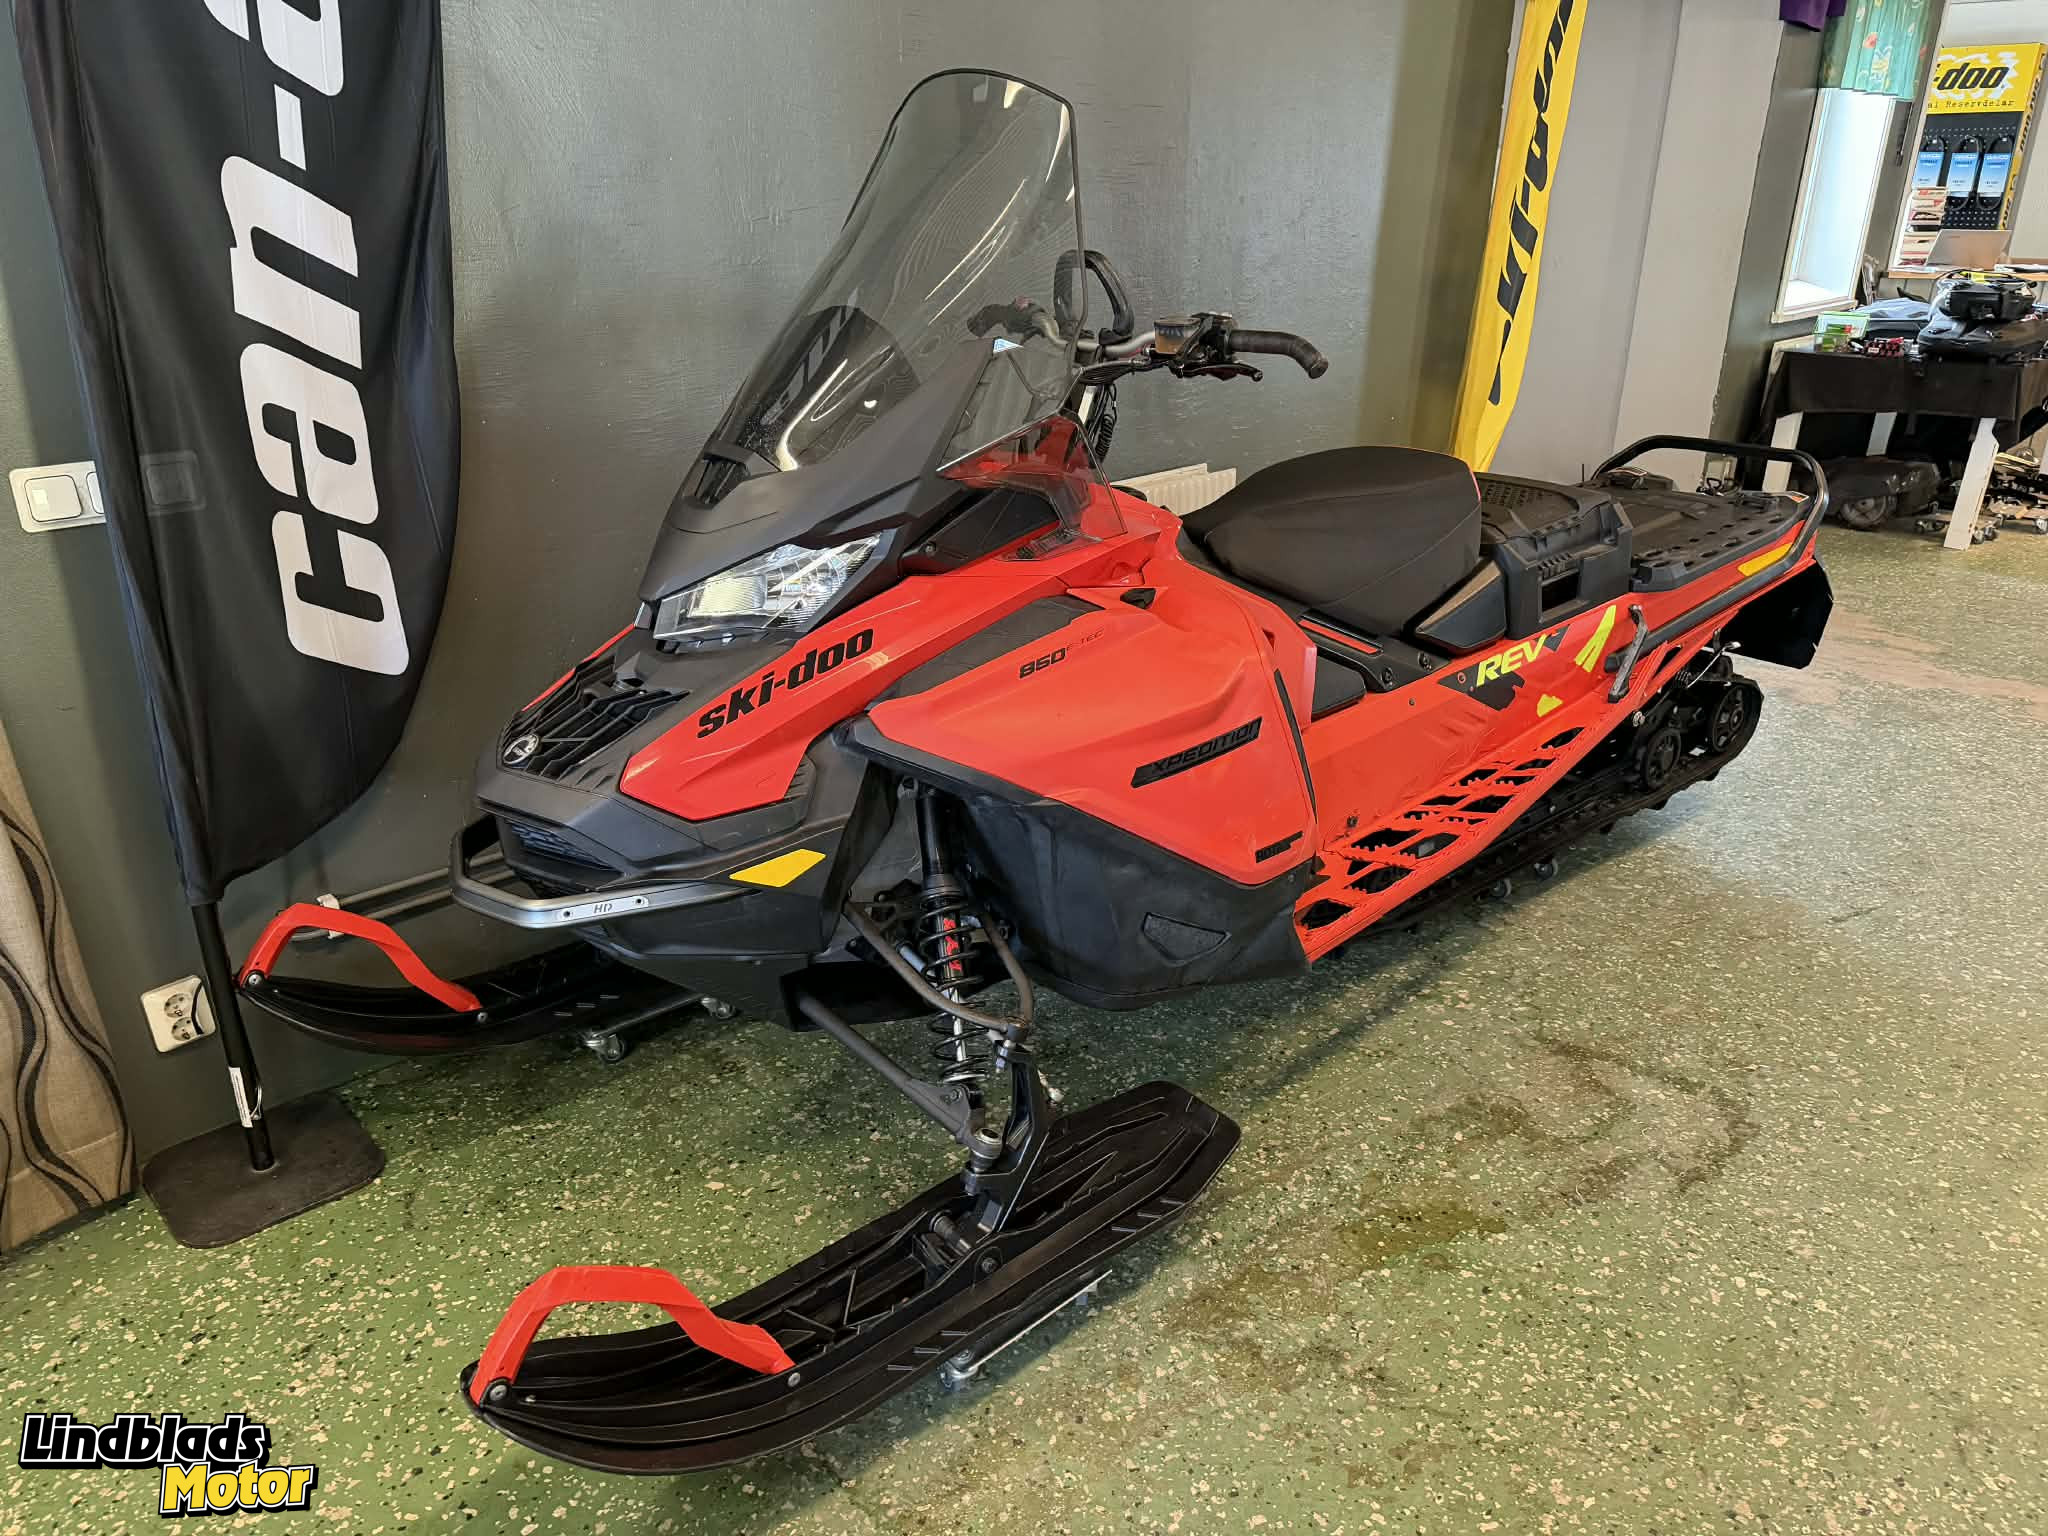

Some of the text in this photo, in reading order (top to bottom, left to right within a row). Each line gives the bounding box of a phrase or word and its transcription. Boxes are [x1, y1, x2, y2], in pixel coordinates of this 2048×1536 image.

[1934, 62, 2010, 90] -doo
[1019, 647, 1066, 680] 850
[1476, 633, 1548, 688] REV
[697, 628, 874, 738] ski-doo
[593, 902, 613, 914] HD
